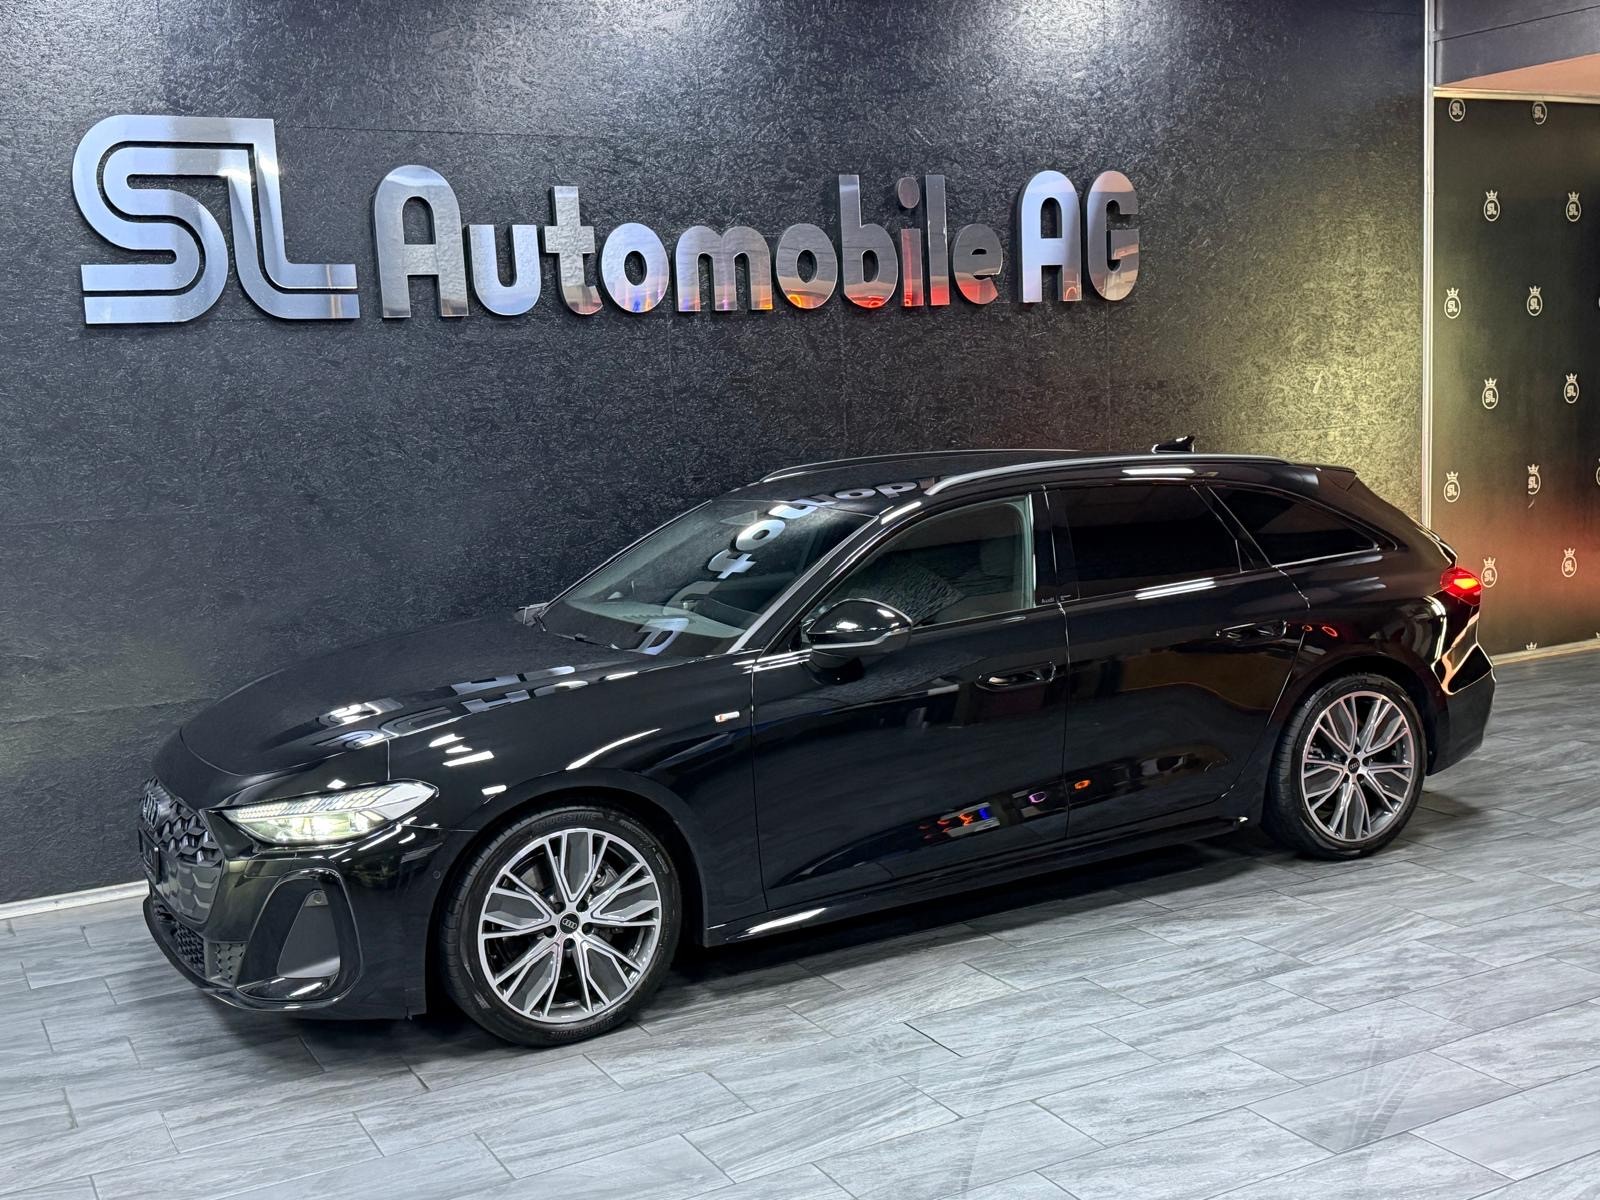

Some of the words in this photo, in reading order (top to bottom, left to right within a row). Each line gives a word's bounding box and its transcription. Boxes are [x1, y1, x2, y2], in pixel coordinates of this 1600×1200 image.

[72, 115, 361, 324] SL
[375, 164, 1003, 318] Automobile
[1020, 169, 1140, 303] AG
